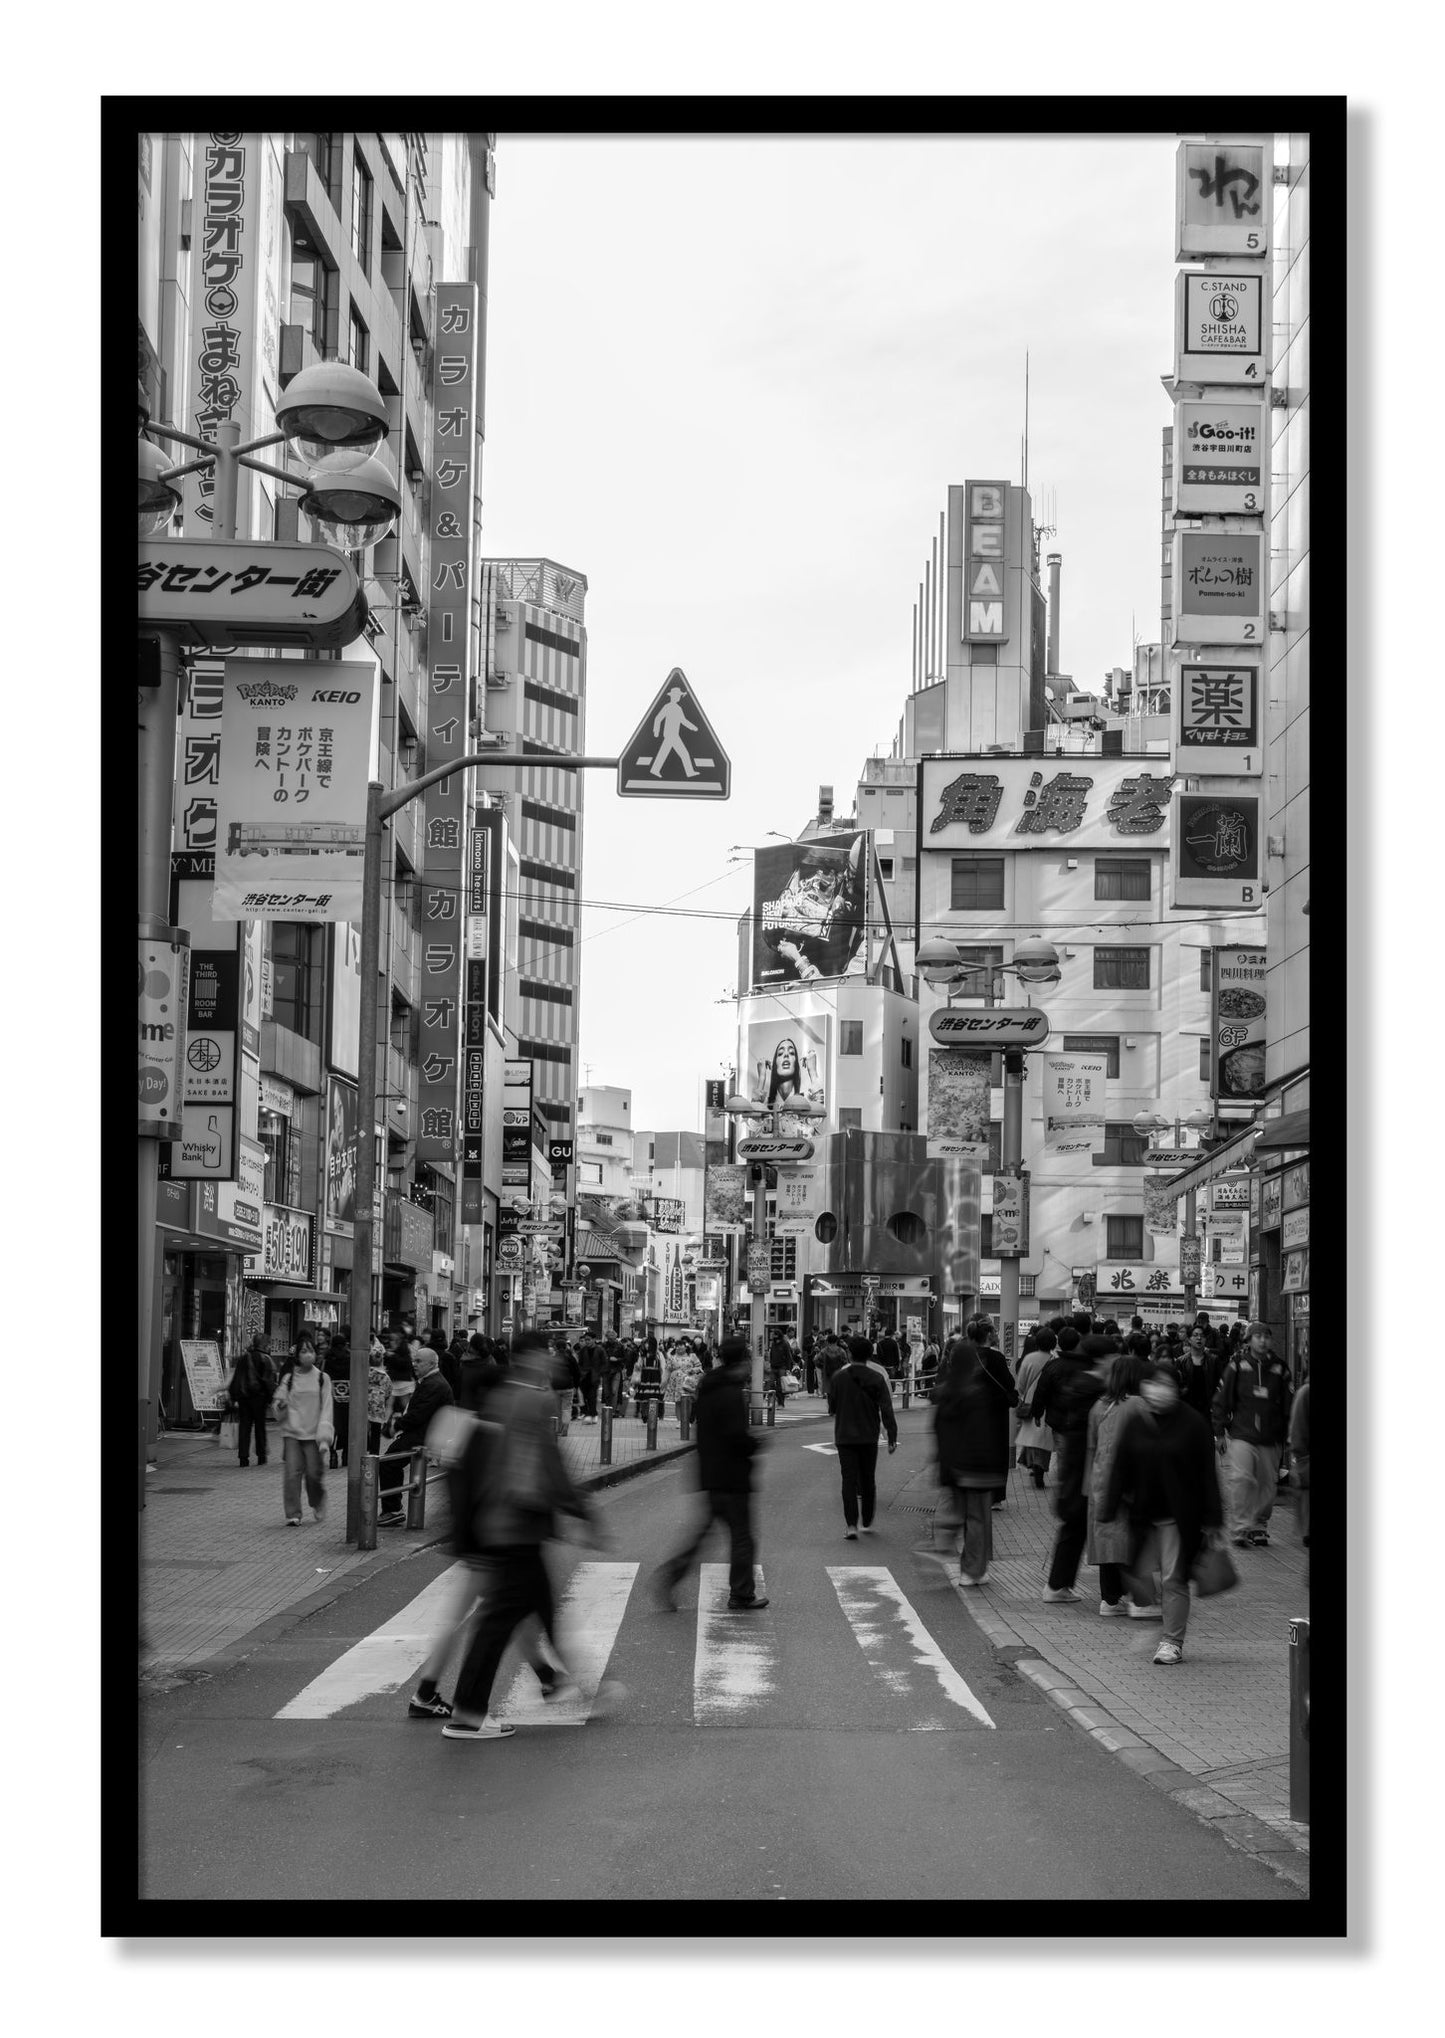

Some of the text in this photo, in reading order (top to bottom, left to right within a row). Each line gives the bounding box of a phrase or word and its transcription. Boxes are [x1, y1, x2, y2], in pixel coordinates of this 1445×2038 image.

[203, 146, 244, 288] カラオケ
[1246, 233, 1259, 249] 5
[1201, 281, 1247, 292] C.STAND
[1201, 323, 1247, 335] SHISHA
[1200, 334, 1247, 344] CAFE&BAR
[1245, 362, 1258, 379] 4
[1199, 423, 1255, 440] Goo-it!
[1192, 443, 1252, 453] 渋谷宇田川町店
[1187, 469, 1256, 482] 全身もみほぐし
[1243, 492, 1257, 510] 3
[969, 485, 1005, 634] BEAM
[1188, 565, 1254, 586] ポムの樹
[1243, 623, 1256, 639] 2
[311, 690, 361, 704] KEIO
[1191, 673, 1243, 726] 薬
[1185, 728, 1249, 743] マツモトキヨシ
[254, 726, 272, 771] 冒険へ
[273, 726, 292, 803] カントーの
[294, 726, 313, 803] ポケパーク
[316, 727, 334, 789] 京王線で
[1243, 754, 1251, 770] 1
[929, 772, 1176, 834] 角海老
[1185, 812, 1248, 862] 一蘭
[474, 832, 484, 870] kimono
[241, 893, 333, 907] 渋谷センター街
[1242, 886, 1254, 902] B
[1218, 1026, 1249, 1048] 6F
[146, 1076, 167, 1091] Day!
[183, 1142, 217, 1154] Whisky
[551, 1146, 572, 1158] GU
[181, 1152, 203, 1162] Bank
[1110, 1268, 1172, 1291] 兆楽
[671, 1267, 682, 1311] BEER
